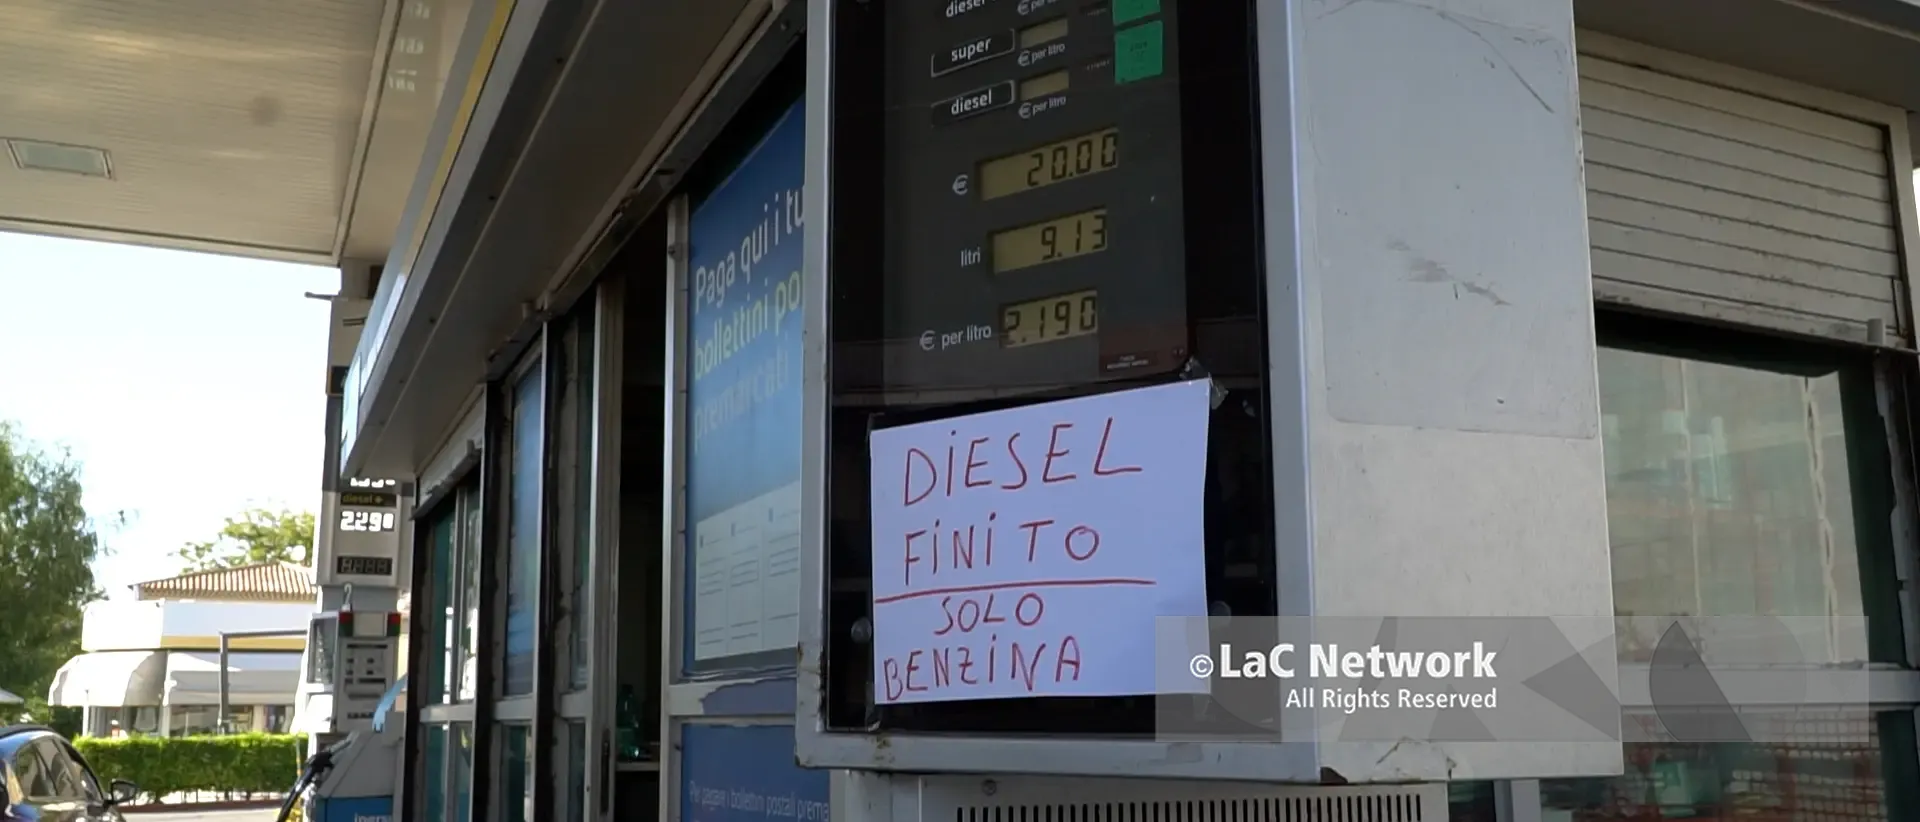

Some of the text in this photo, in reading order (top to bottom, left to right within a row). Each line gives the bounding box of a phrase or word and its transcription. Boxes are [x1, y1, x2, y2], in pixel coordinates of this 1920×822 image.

[951, 37, 992, 62] super
[1031, 48, 1047, 64] per
[1047, 43, 1066, 56] litro
[951, 89, 992, 115] diesel
[1032, 101, 1048, 117] per
[1048, 96, 1067, 109] litro
[1027, 132, 1118, 188] 20.00
[695, 251, 736, 315] Paga
[740, 203, 769, 284] qui
[774, 193, 780, 246] i
[960, 247, 981, 267] litri
[1040, 214, 1107, 261] 9.13
[695, 269, 805, 381] bollettini po
[941, 329, 964, 350] per
[966, 323, 992, 342] litro
[1003, 296, 1098, 347] 2.190
[694, 333, 788, 450] premarcati
[934, 593, 1044, 635] SOLO
